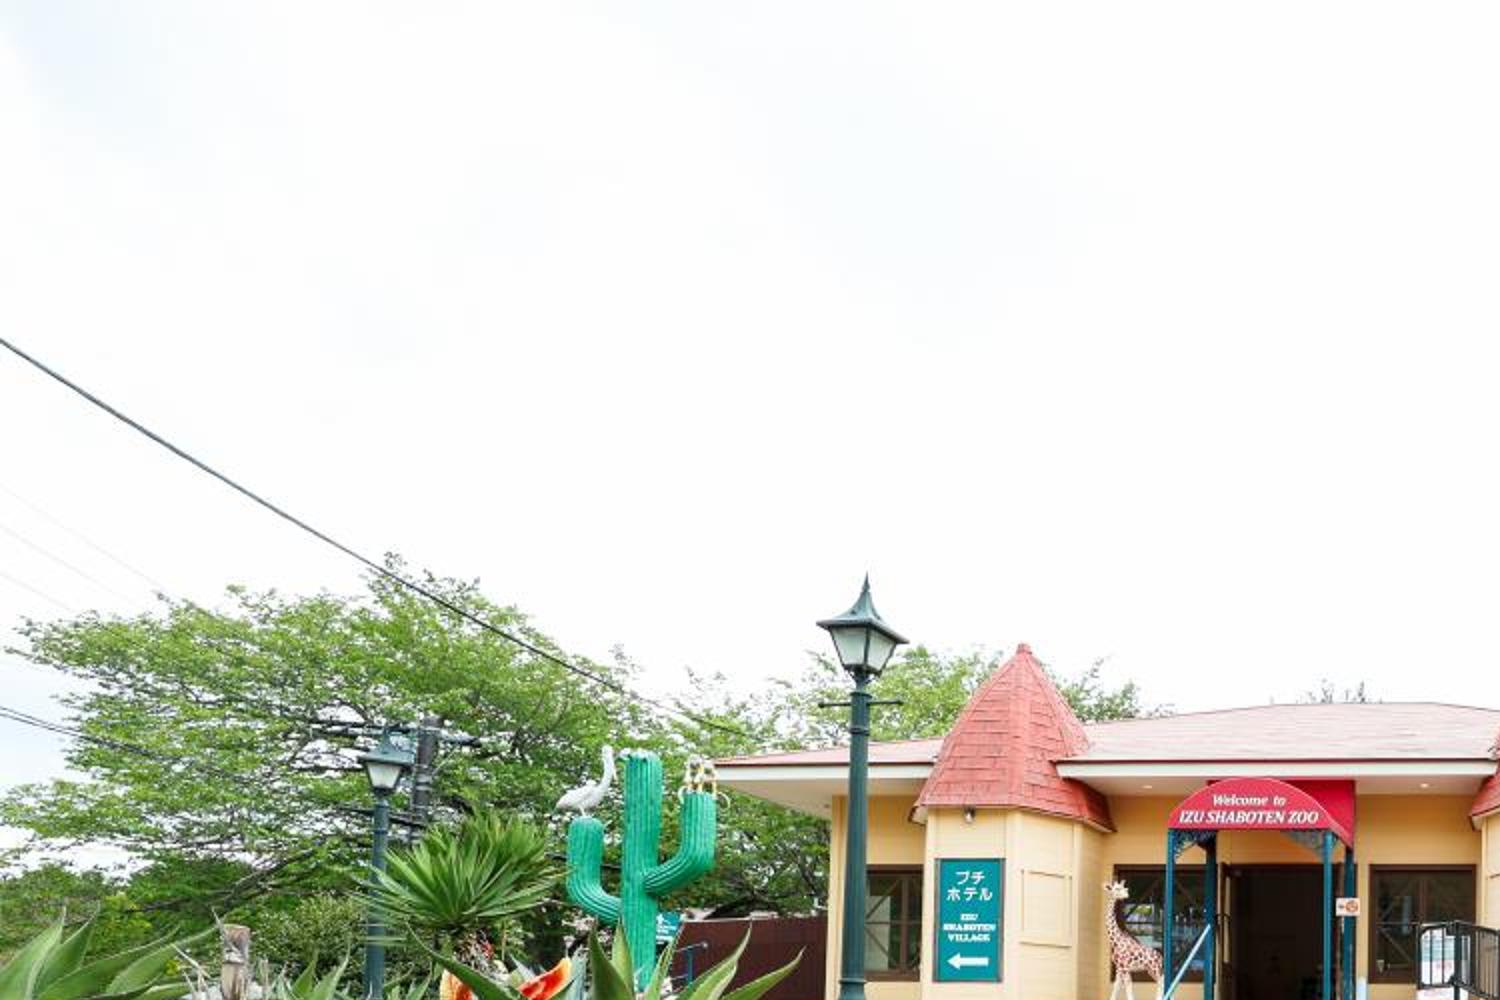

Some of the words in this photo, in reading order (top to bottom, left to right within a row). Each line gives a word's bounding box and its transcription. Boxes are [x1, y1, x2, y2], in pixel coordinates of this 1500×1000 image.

[1213, 794, 1268, 807] Welcome
[1273, 795, 1286, 807] to
[1179, 810, 1204, 824] IZU
[1208, 810, 1285, 824] SHABOTEN
[1287, 810, 1319, 824] ZOO
[955, 870, 985, 885] プチ
[946, 887, 993, 902] ホテル
